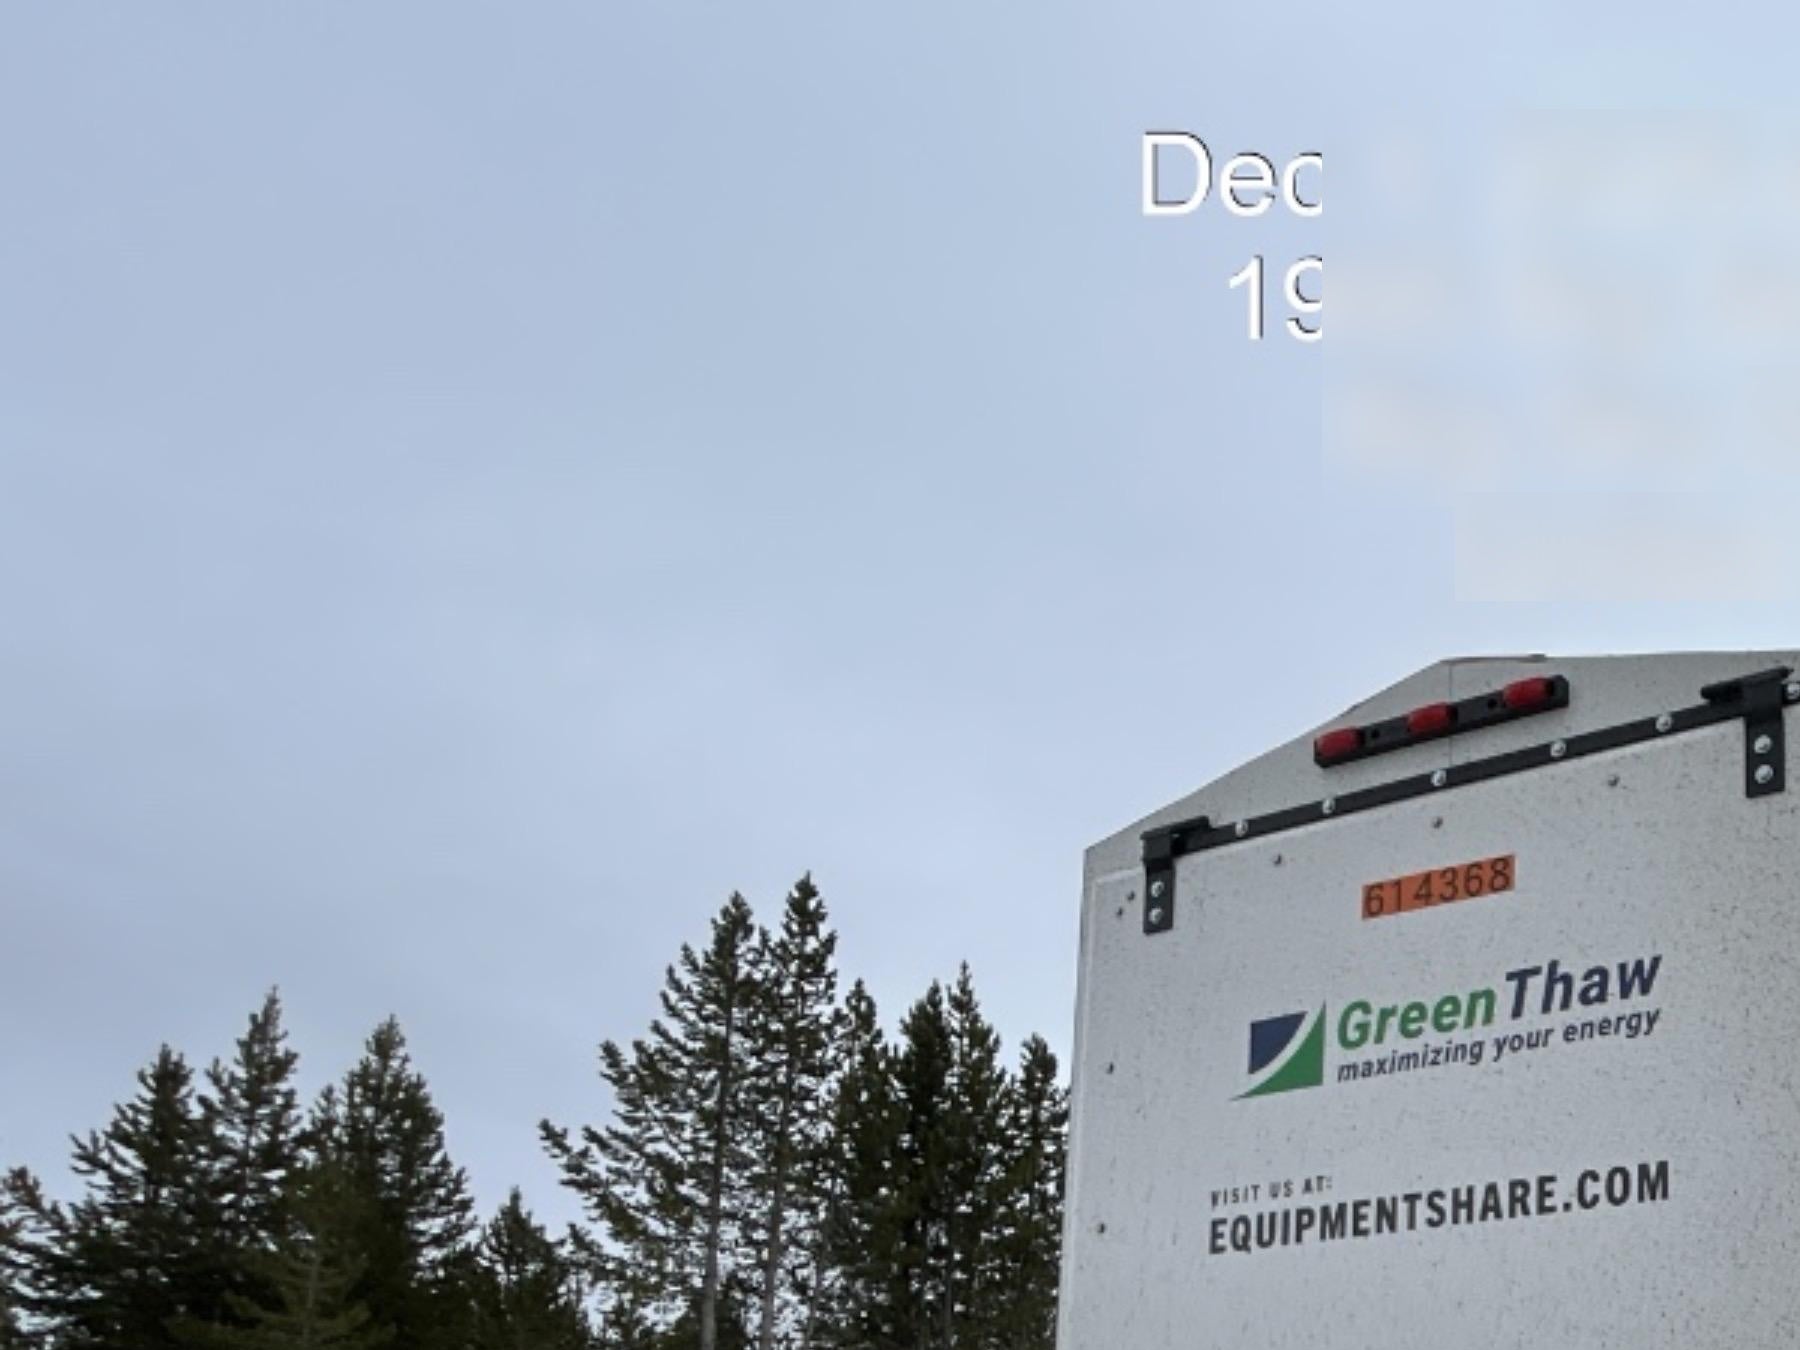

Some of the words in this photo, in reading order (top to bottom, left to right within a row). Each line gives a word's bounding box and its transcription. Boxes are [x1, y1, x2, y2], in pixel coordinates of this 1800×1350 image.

[1364, 857, 1511, 918] 614368
[1337, 1039, 1485, 1083] maximizing
[1493, 1028, 1554, 1062] your
[1563, 1008, 1660, 1043] energy
[1209, 1160, 1669, 1255] EQUIPMENTSHARE.COM
[1211, 1184, 1260, 1210] VISIT
[1269, 1179, 1294, 1199] US
